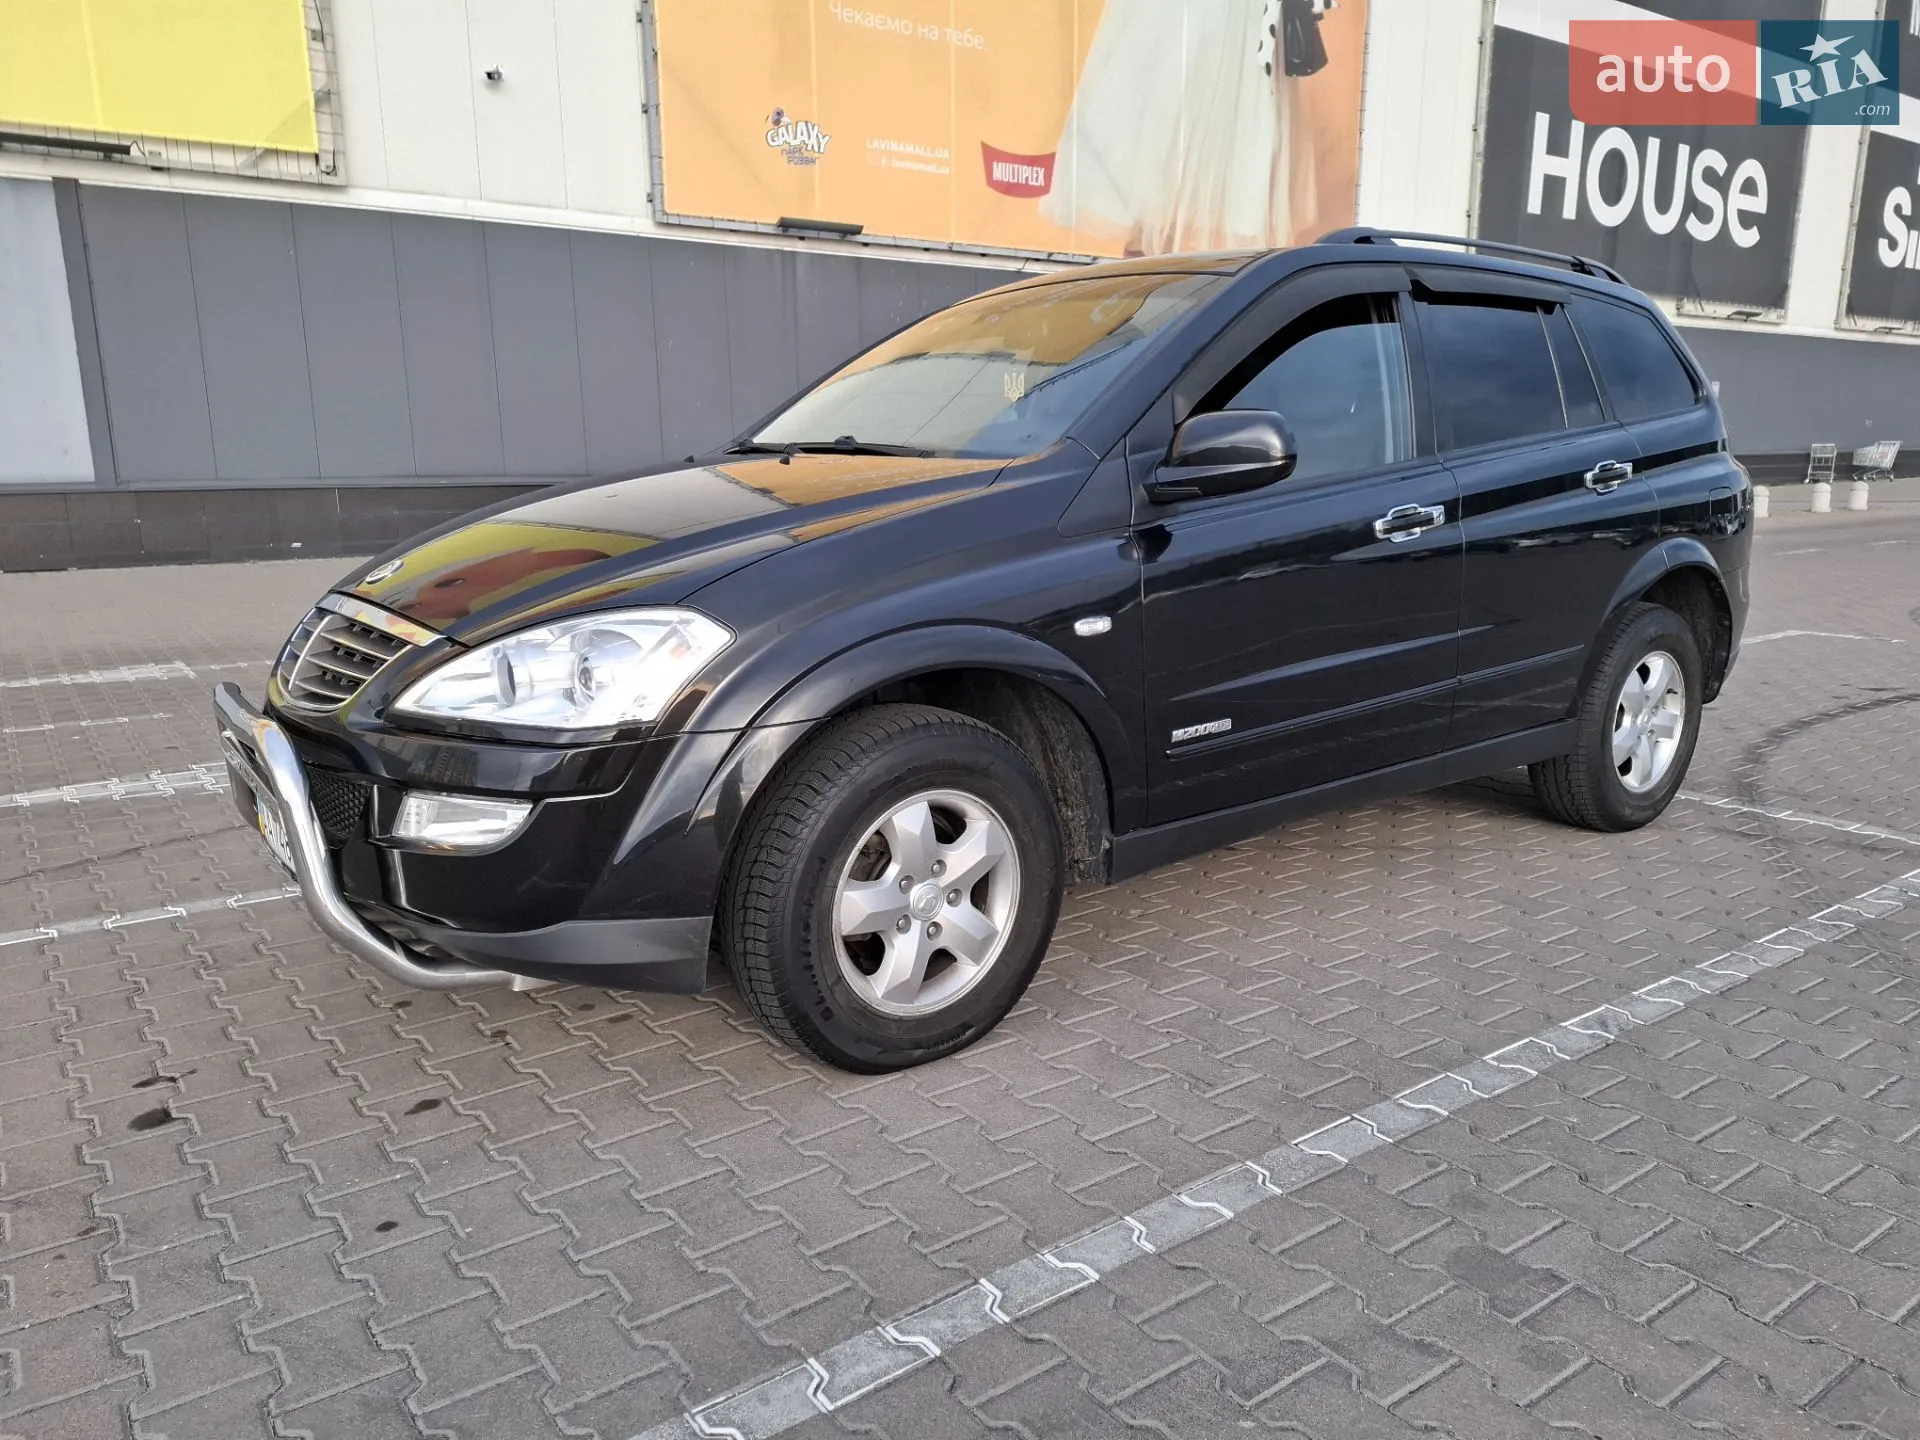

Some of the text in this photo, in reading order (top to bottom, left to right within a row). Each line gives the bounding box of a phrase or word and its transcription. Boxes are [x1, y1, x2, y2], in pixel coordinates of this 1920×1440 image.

[828, 0, 988, 51] Чекаємо на тебе.
[766, 121, 831, 154] GALAXY
[992, 161, 1045, 186] MULTIPLEX
